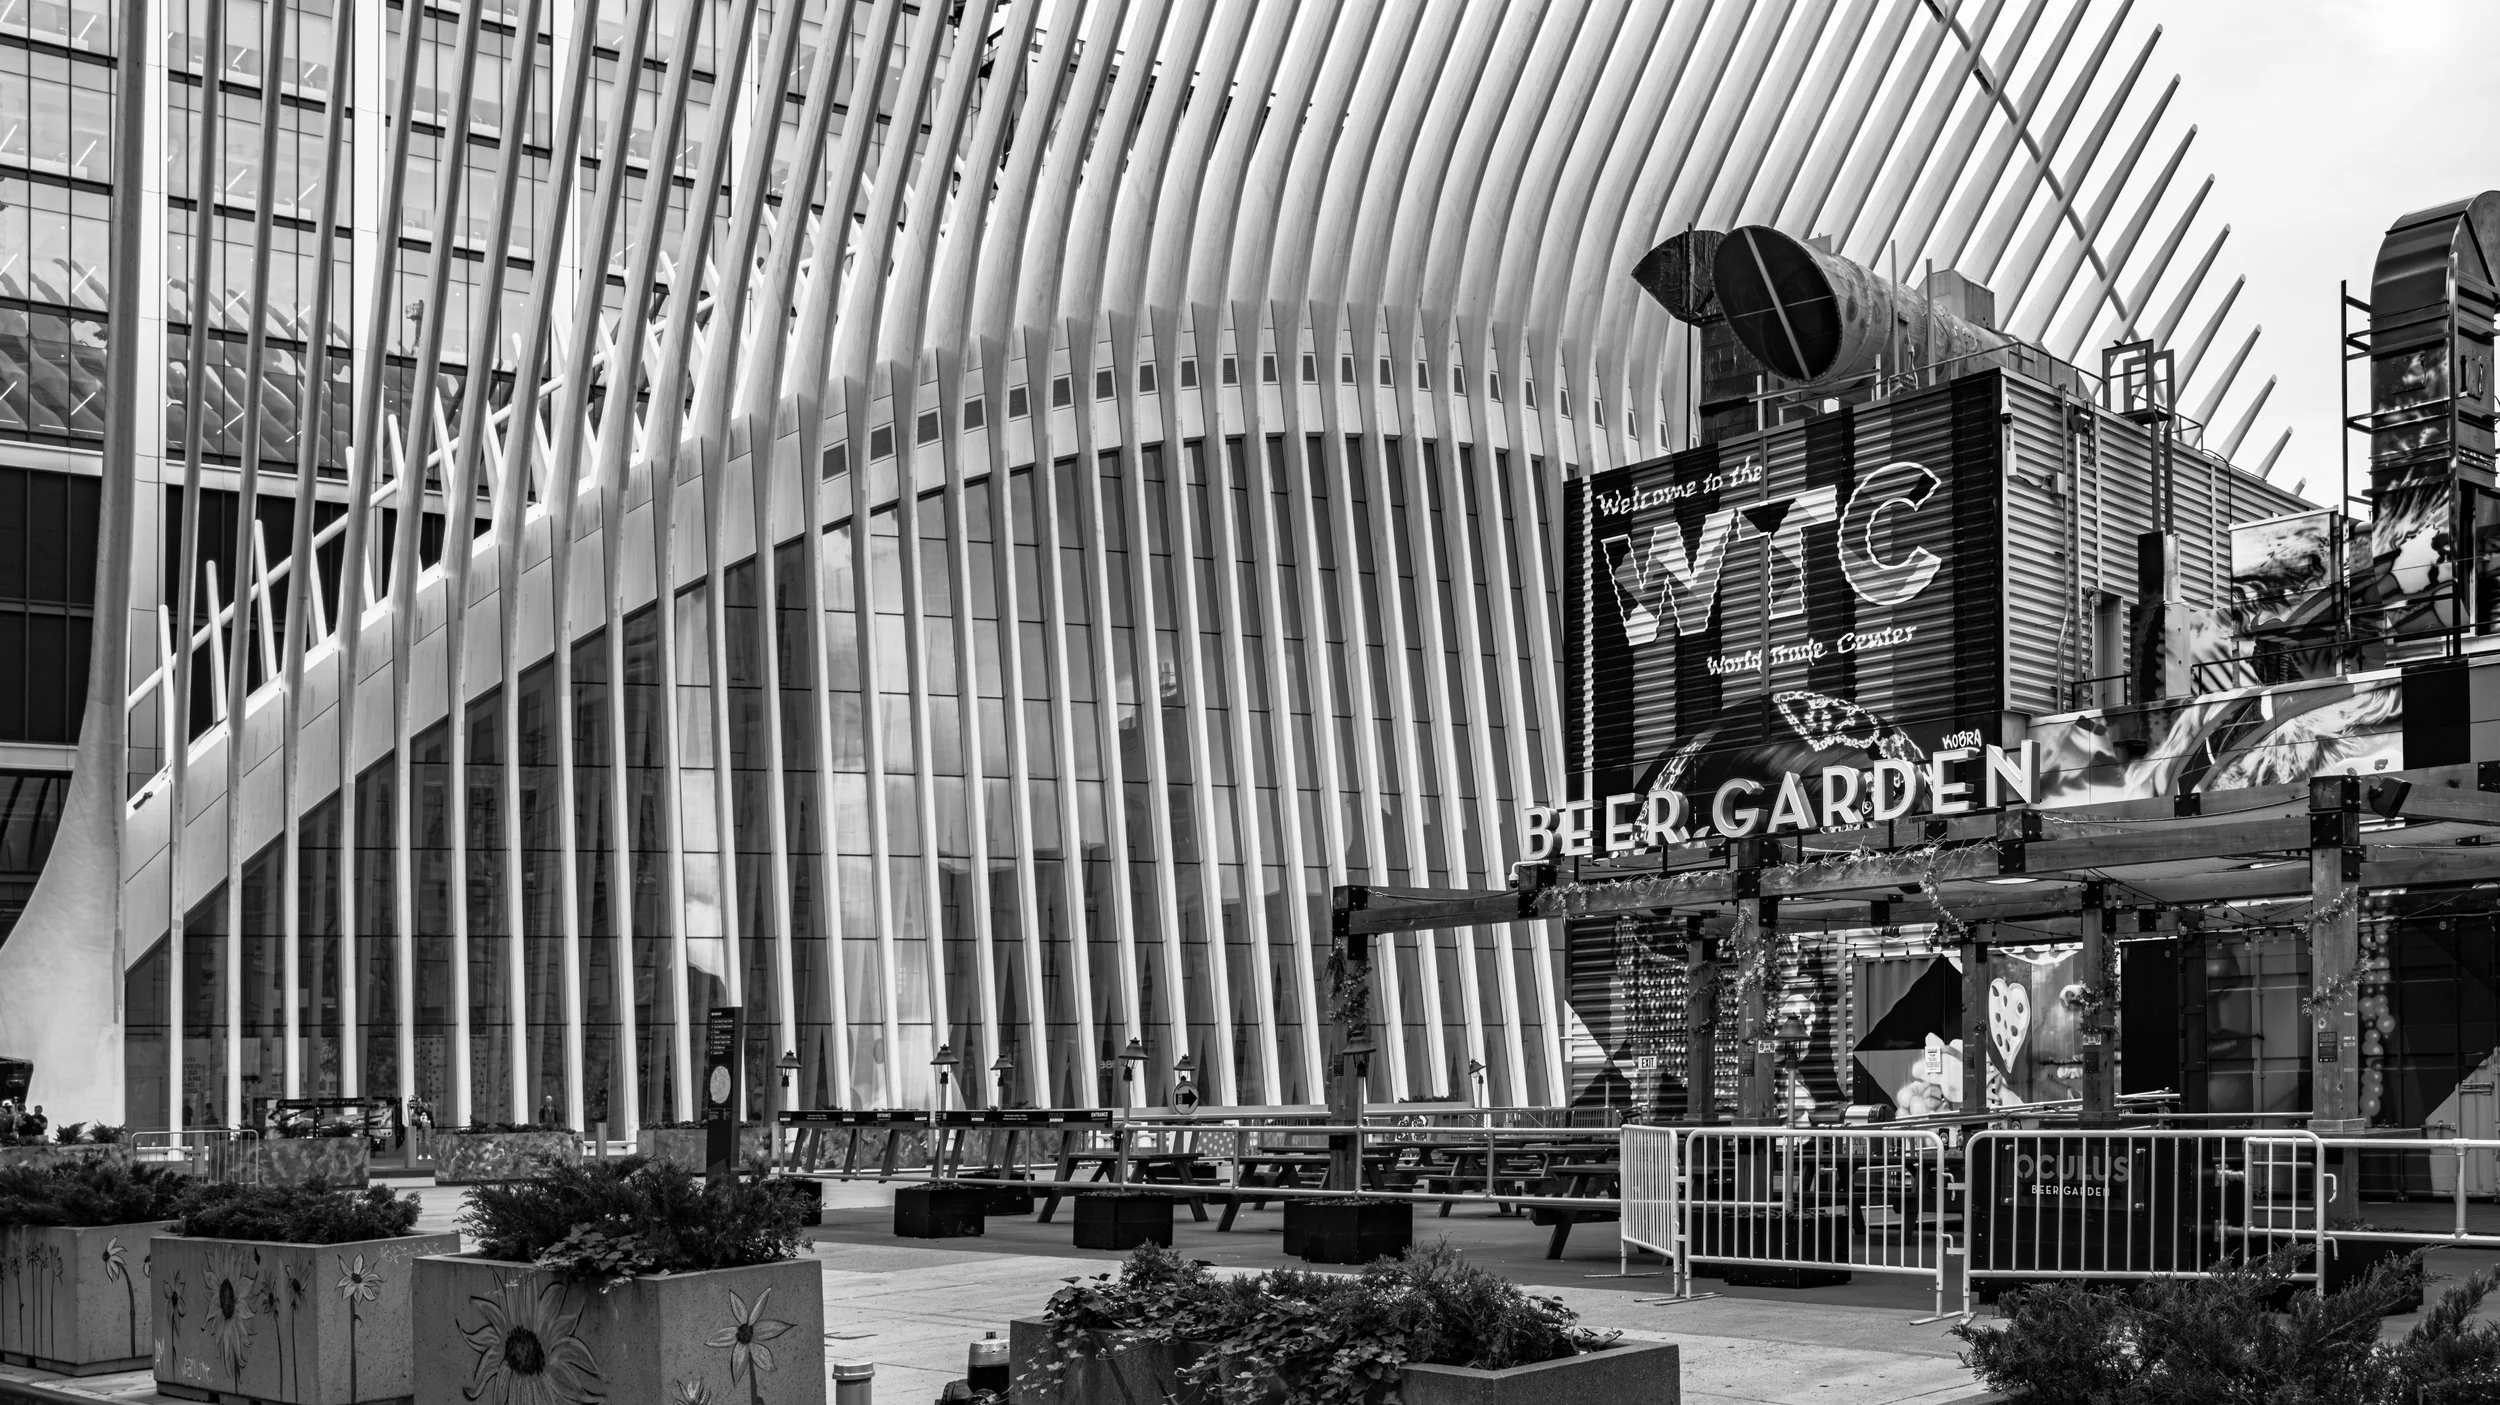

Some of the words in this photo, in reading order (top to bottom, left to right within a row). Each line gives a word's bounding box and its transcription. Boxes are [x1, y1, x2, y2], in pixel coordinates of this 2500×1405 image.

[1595, 480, 1697, 517] Welcome
[1703, 472, 1724, 494] to
[1729, 455, 1763, 488] the
[1601, 460, 1943, 647] WTC
[1706, 648, 1763, 676] World
[1768, 638, 1828, 667] Trade
[1836, 626, 1918, 654] Center
[1942, 728, 1983, 750] KOBRA
[1523, 788, 1690, 863] BEER
[1712, 738, 2042, 839] GARDEN
[1641, 1057, 1655, 1068] EXIT
[2014, 1153, 2130, 1182] OCULUS
[2031, 1184, 2059, 1196] BEER
